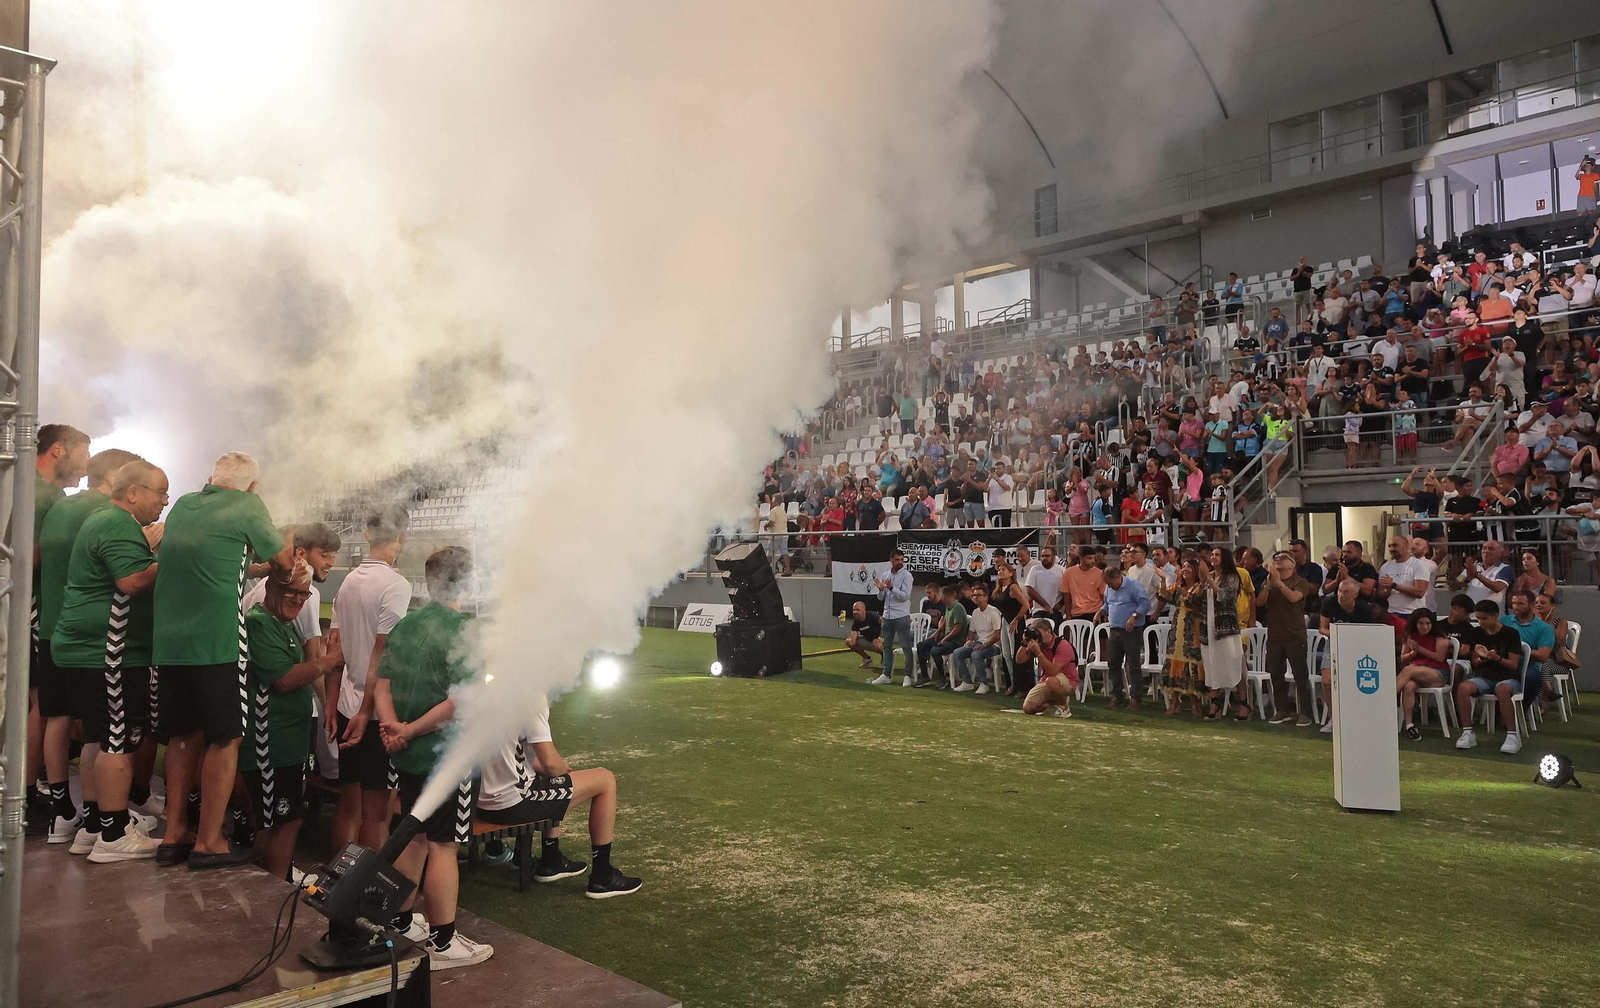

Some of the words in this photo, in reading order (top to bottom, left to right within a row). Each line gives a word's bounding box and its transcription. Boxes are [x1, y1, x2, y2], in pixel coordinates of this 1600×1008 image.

[901, 543, 943, 551] SIEMPRE
[918, 556, 941, 565] SER
[905, 564, 941, 572] INENSE
[683, 617, 714, 627] LOTUS
